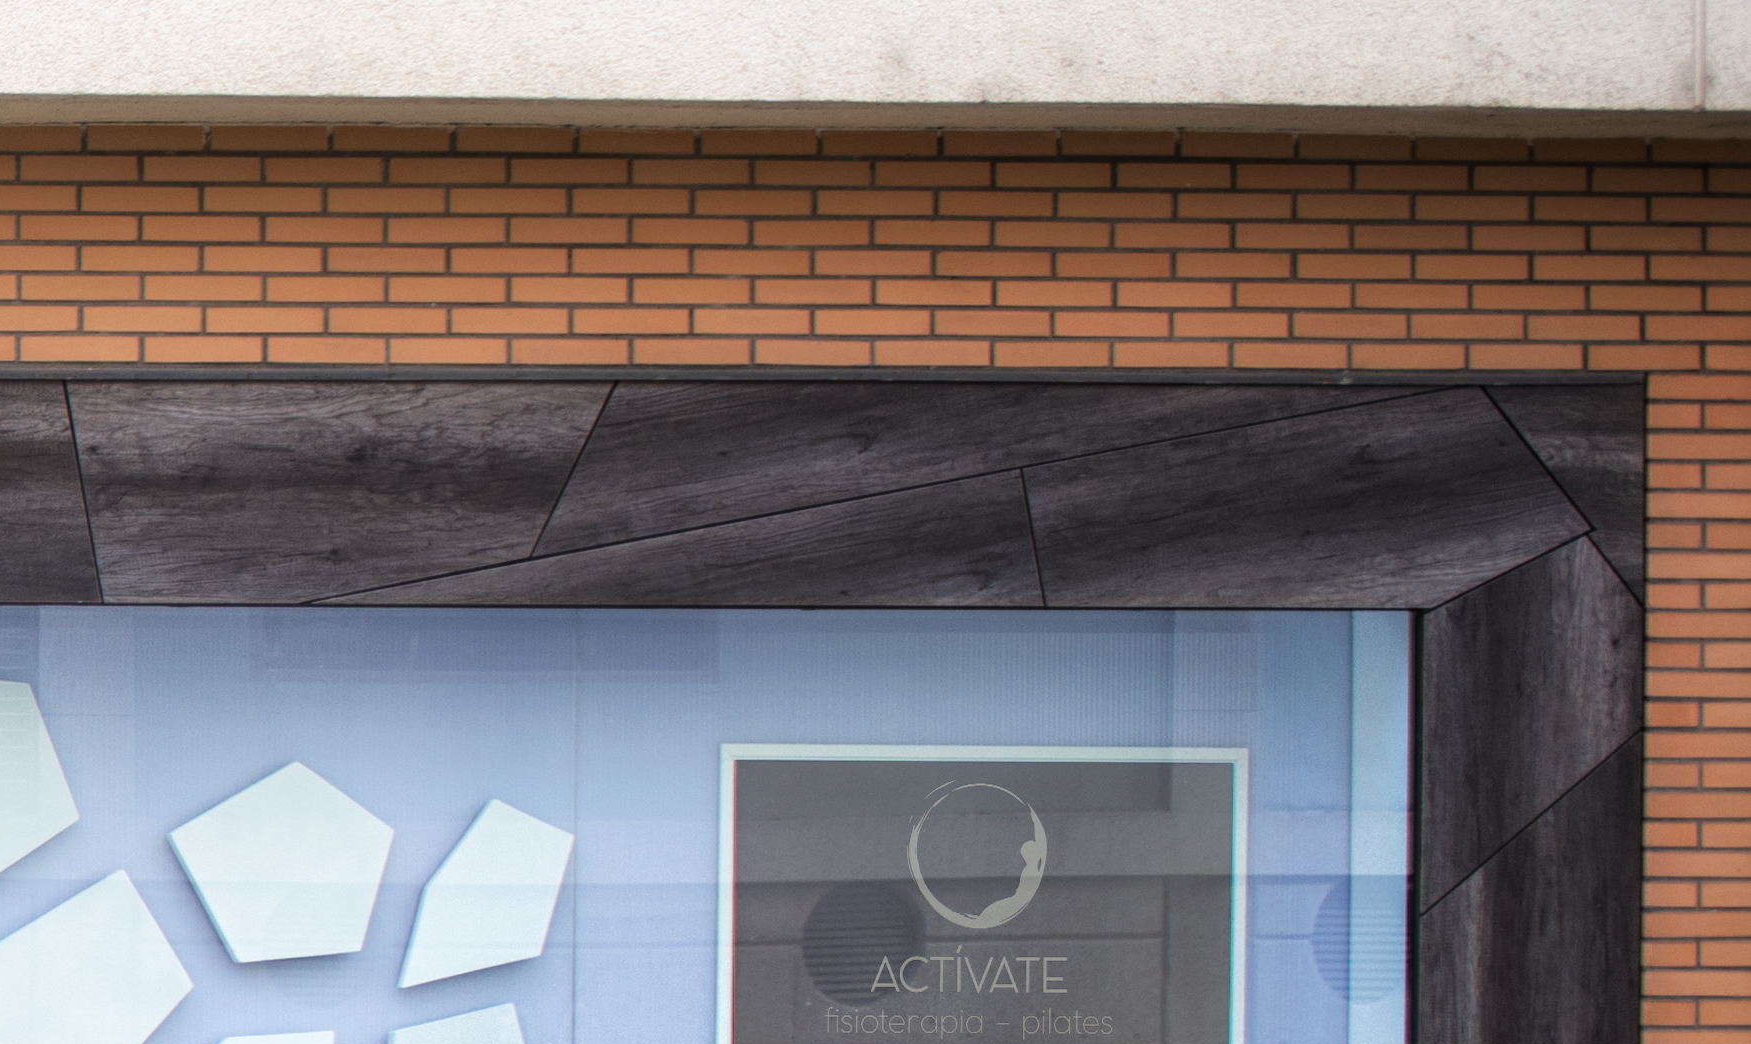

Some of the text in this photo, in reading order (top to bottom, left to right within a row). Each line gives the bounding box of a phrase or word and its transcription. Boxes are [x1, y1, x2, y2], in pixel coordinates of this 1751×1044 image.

[870, 945, 1068, 993] ACTÍVATE
[824, 1006, 983, 1040] fisioterapia
[1022, 1007, 1113, 1040] pilates
